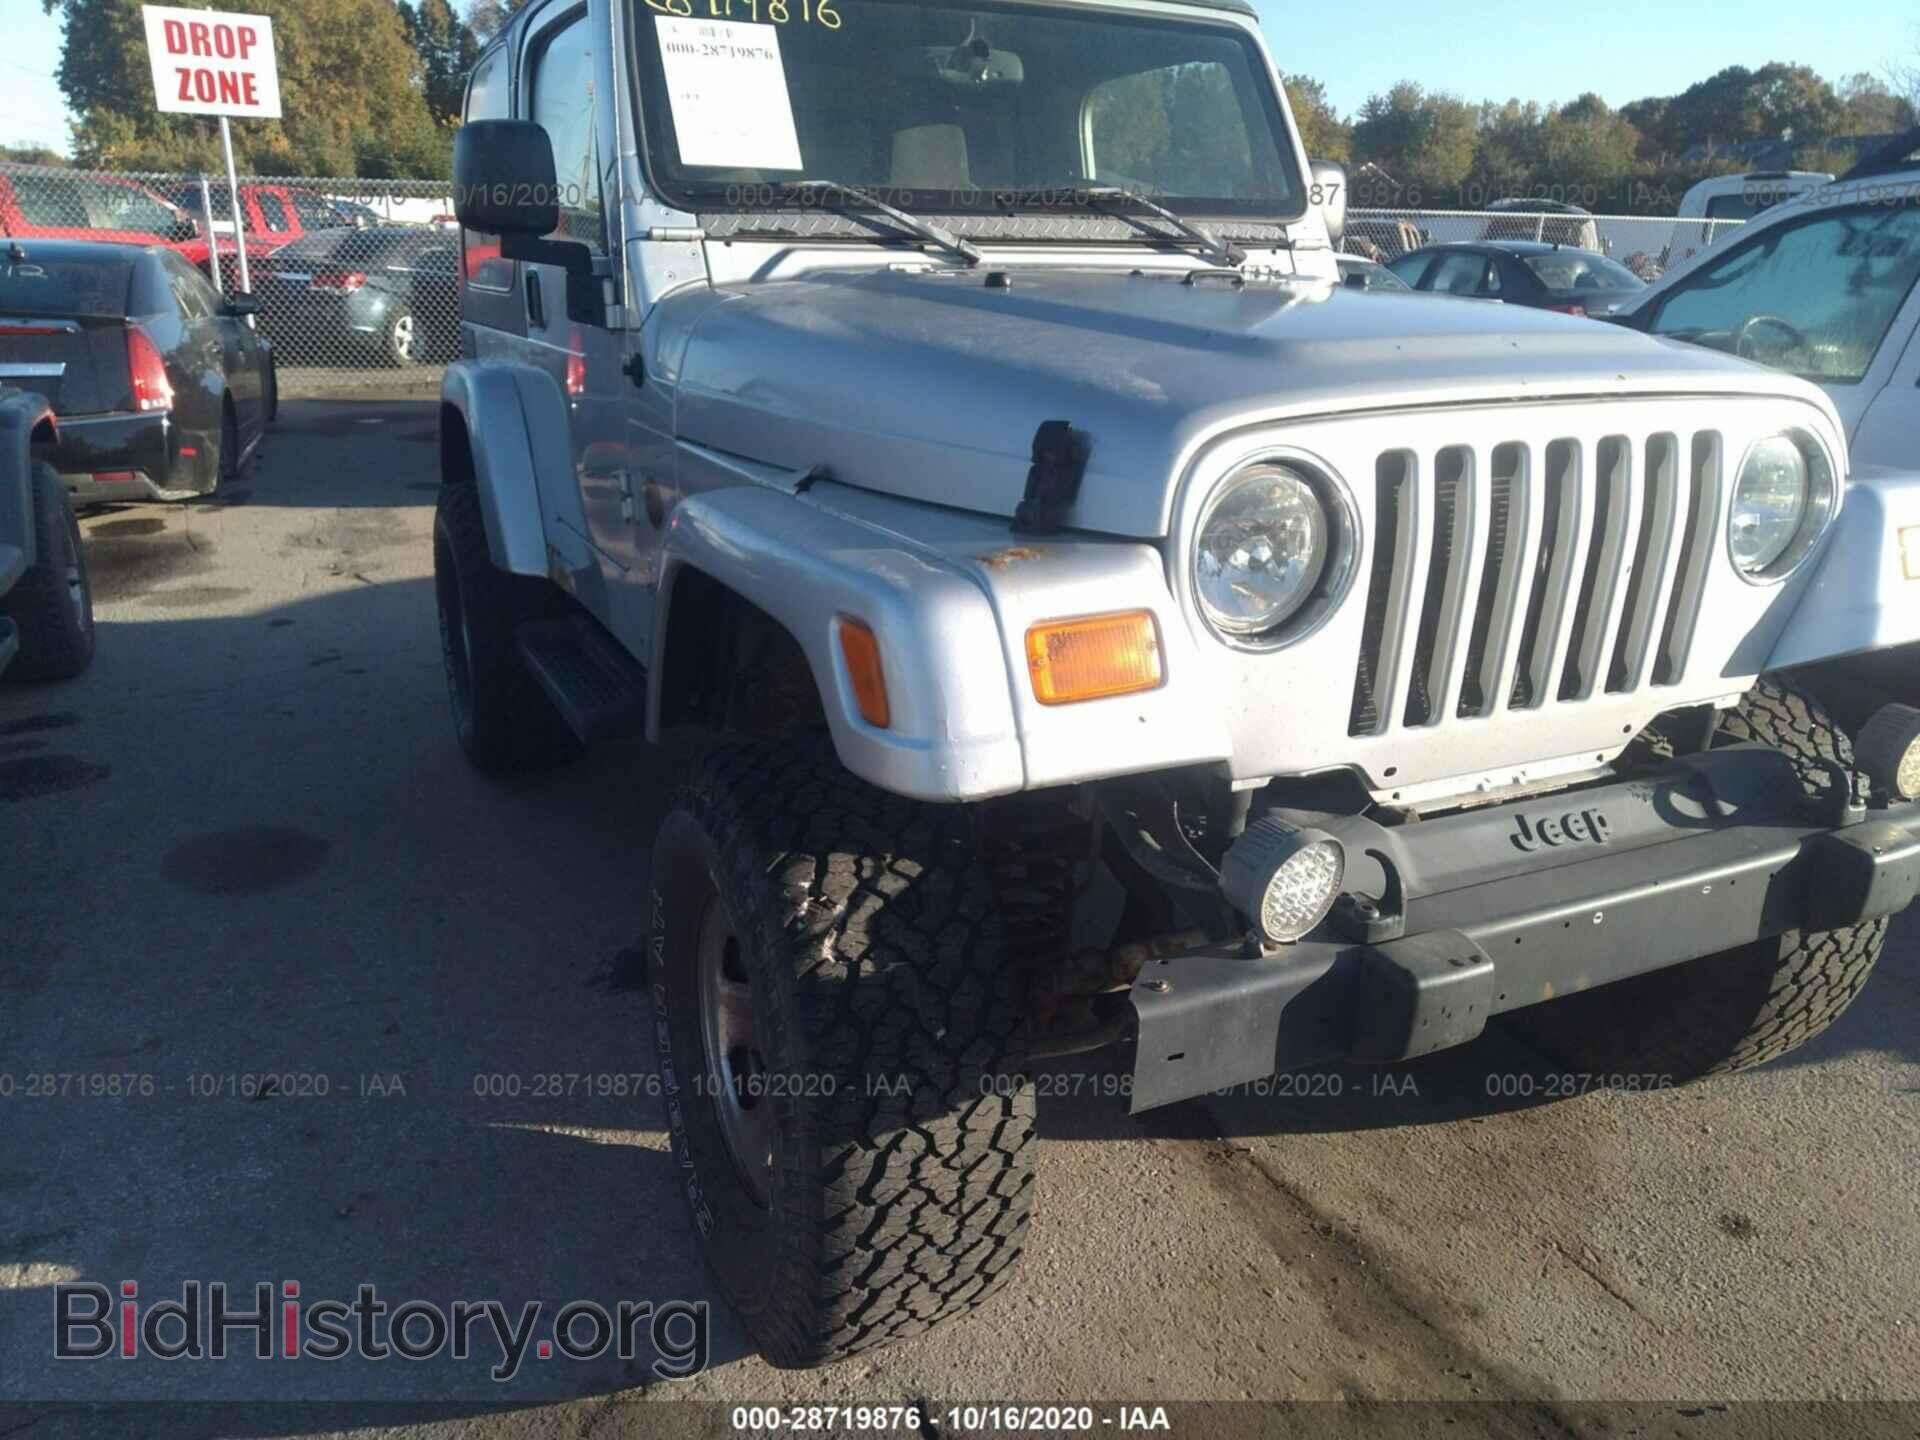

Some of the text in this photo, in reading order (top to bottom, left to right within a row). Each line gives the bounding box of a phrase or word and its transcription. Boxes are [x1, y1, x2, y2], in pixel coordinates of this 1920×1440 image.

[163, 19, 257, 60] DROP
[174, 67, 260, 106] ZONE
[1510, 808, 1612, 852] Jeep
